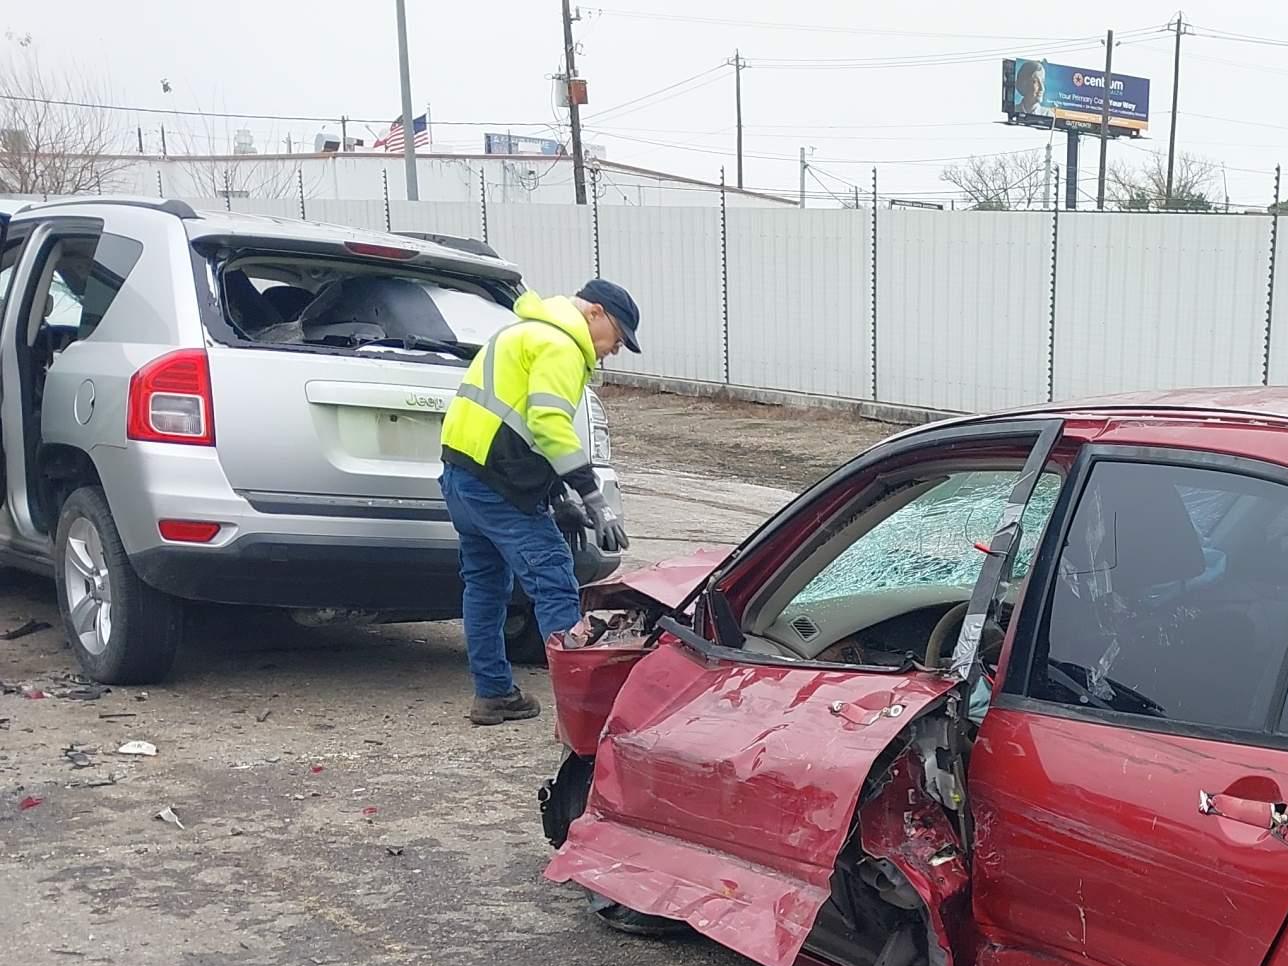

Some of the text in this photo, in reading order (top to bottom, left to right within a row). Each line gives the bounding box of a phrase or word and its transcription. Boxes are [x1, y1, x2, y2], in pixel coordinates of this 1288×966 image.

[1084, 76, 1123, 90] centum
[1072, 94, 1092, 104] Primary
[1123, 101, 1136, 111] Way
[406, 391, 444, 410] Jeep
